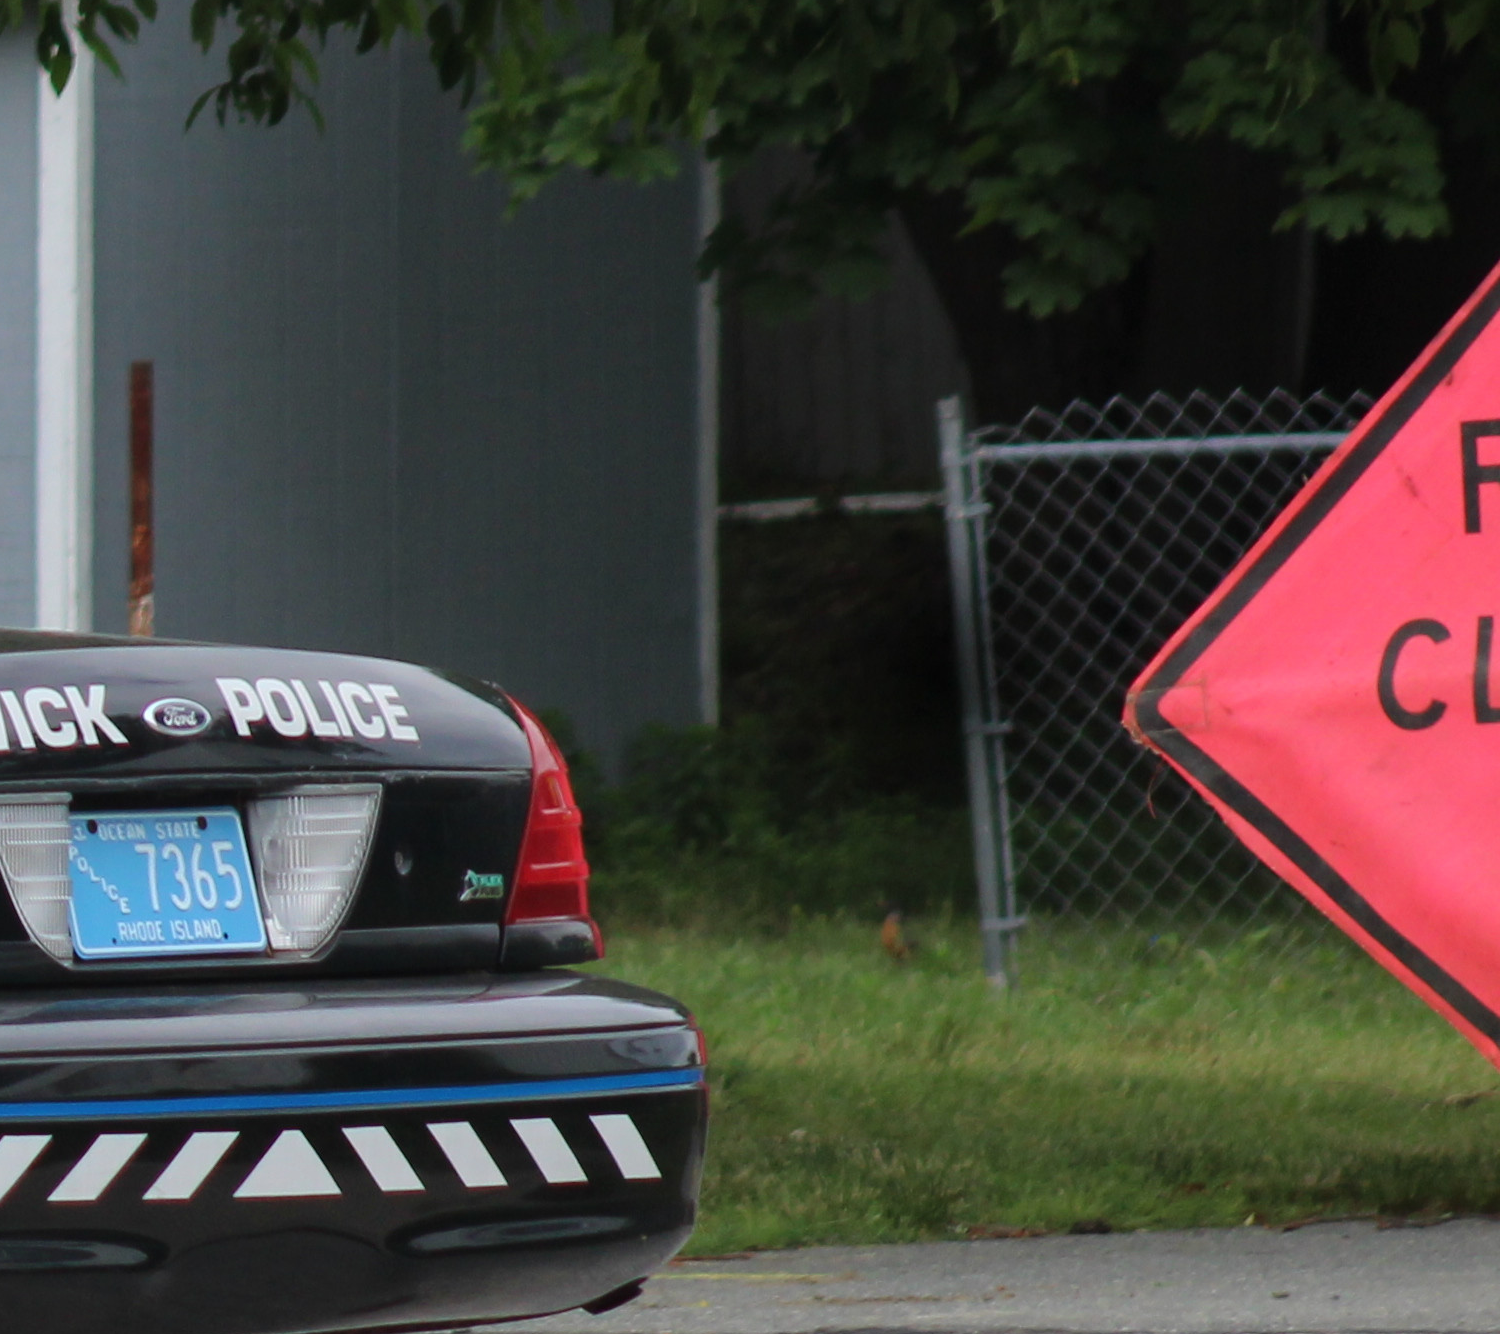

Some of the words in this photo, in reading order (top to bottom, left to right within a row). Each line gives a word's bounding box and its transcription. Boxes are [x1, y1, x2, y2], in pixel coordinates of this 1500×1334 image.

[216, 677, 421, 743] POLICE
[98, 822, 146, 841] OCEAN
[155, 820, 201, 839] STATE
[68, 846, 131, 914] POLICE
[134, 840, 243, 912] 7365
[117, 920, 165, 942] RHODE
[170, 918, 223, 941] ISLAND
